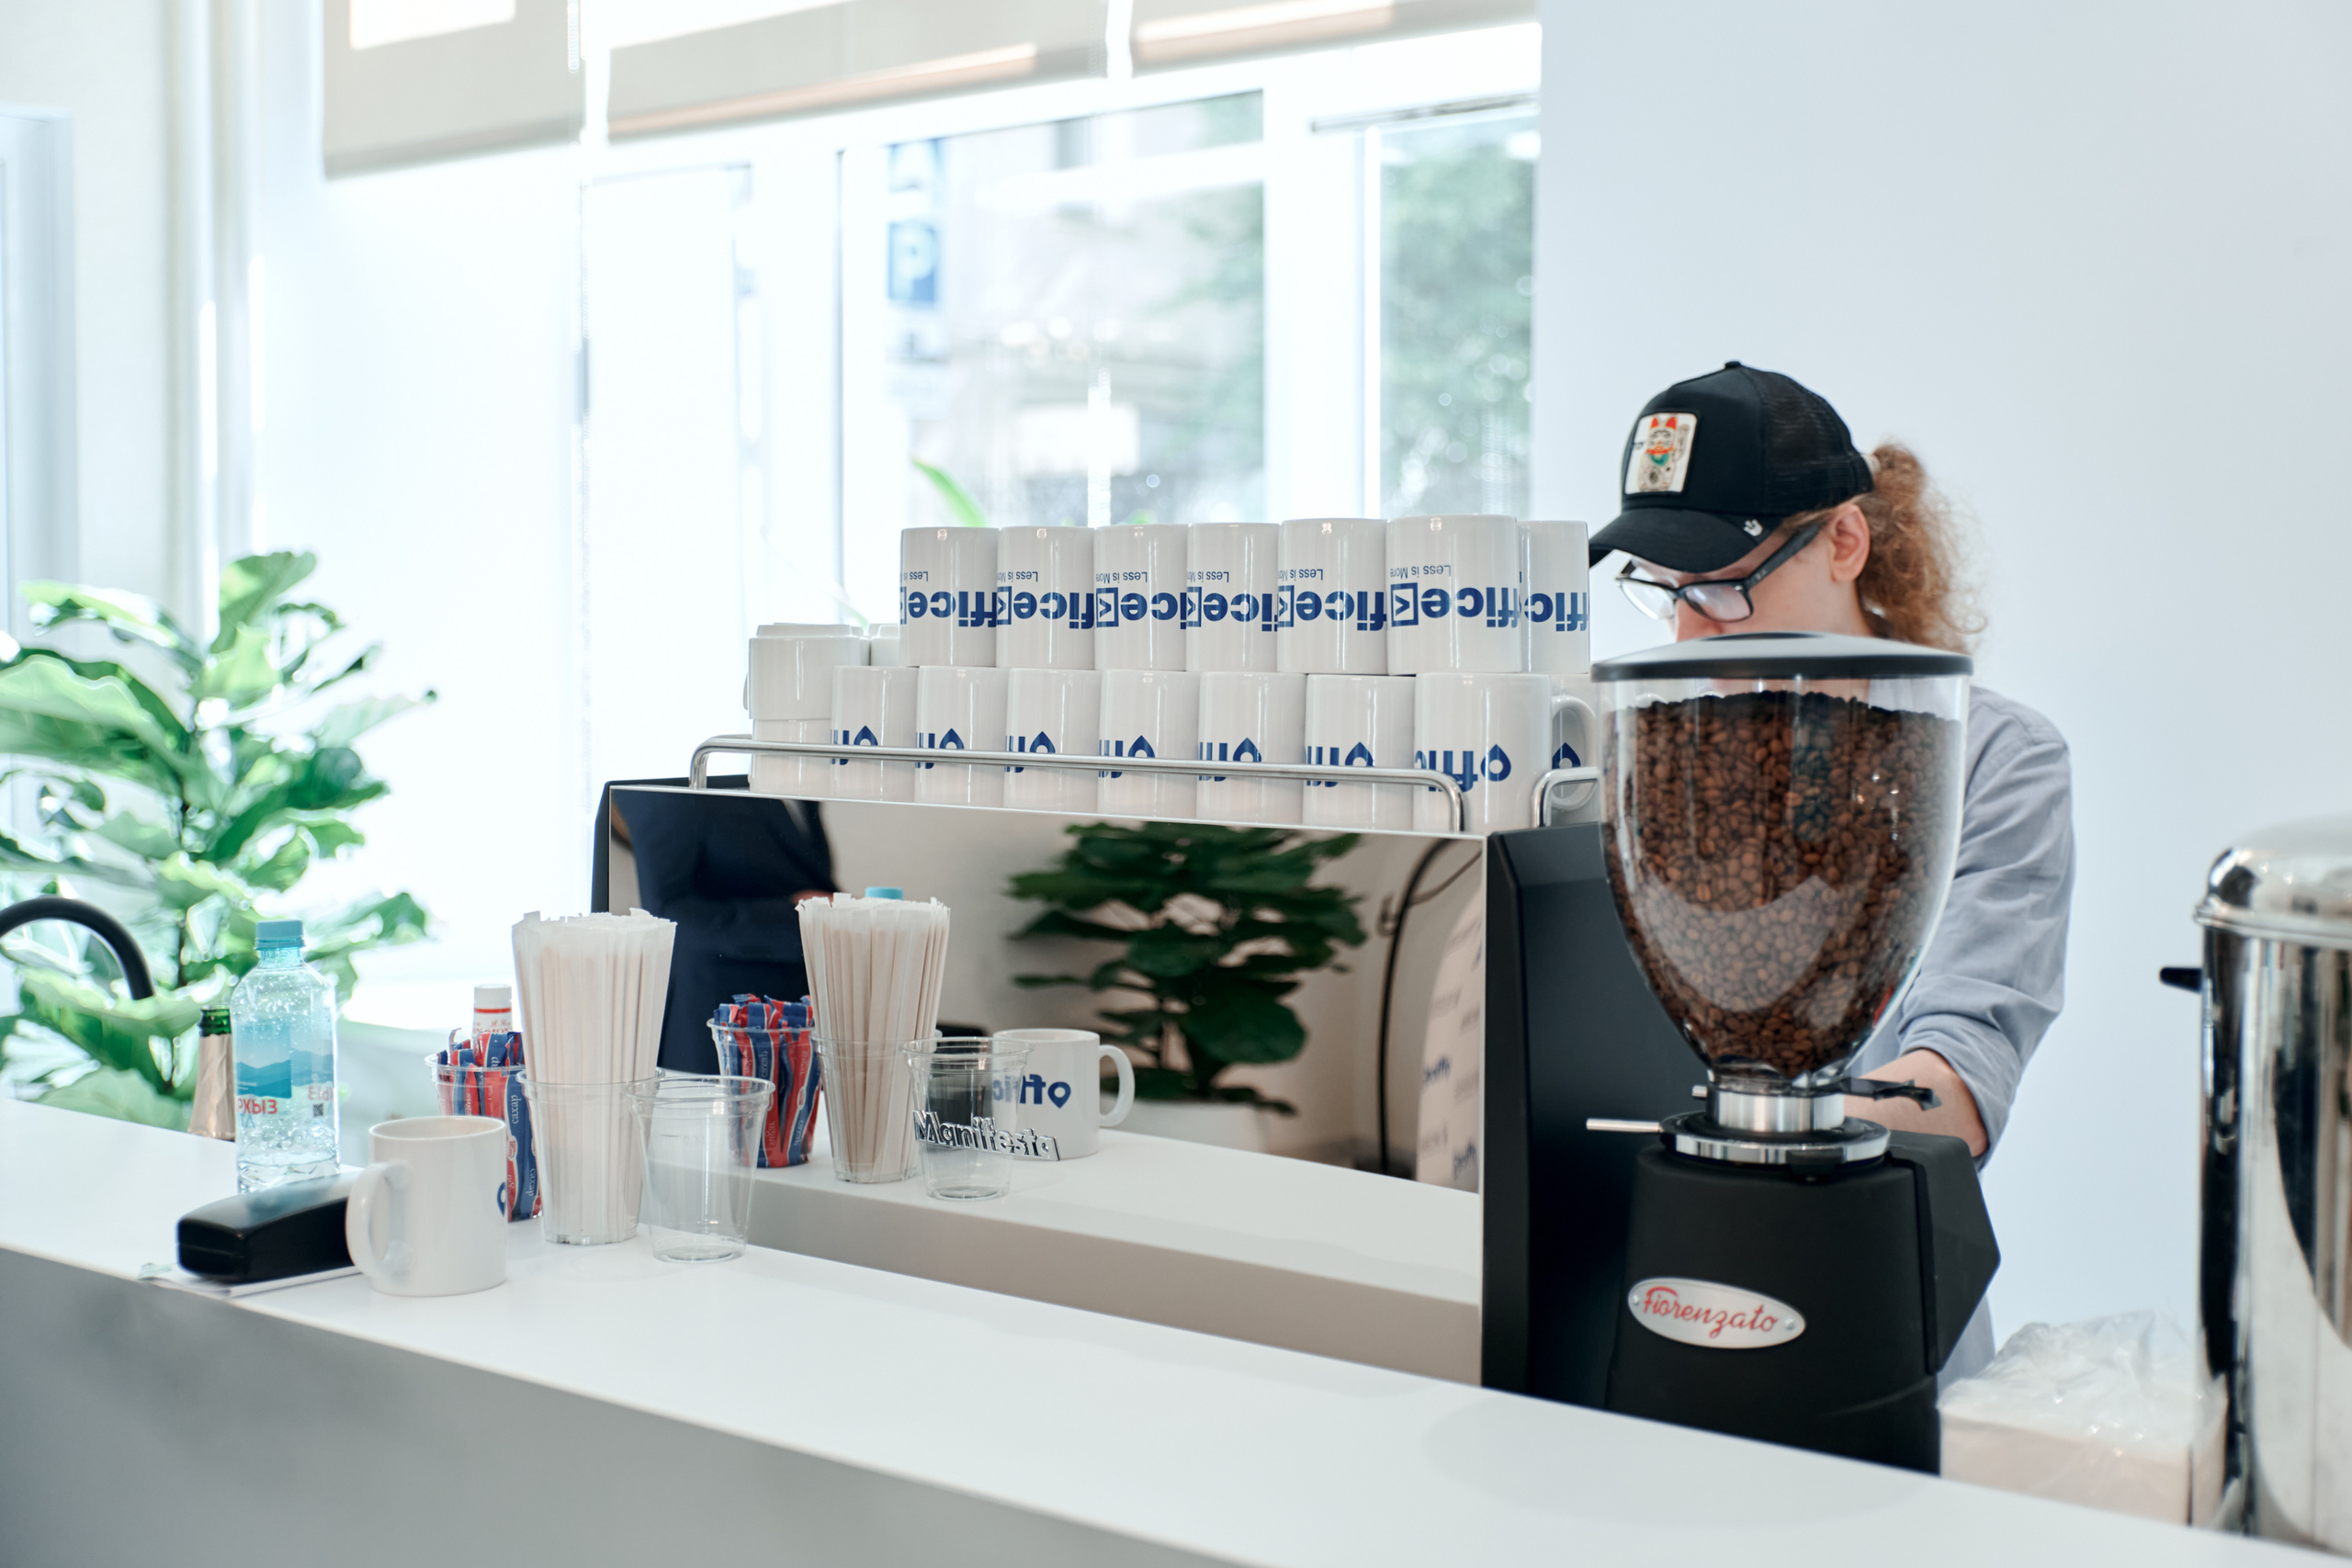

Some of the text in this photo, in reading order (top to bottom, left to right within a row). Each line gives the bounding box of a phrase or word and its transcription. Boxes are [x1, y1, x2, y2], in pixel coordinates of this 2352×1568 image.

[910, 571, 928, 581] Less
[1008, 571, 1013, 582] is
[1016, 571, 1038, 582] Less
[1096, 571, 1148, 583] Less is More
[1197, 571, 1204, 582] is
[1205, 570, 1229, 582] Less
[1290, 570, 1296, 581] is
[1299, 569, 1323, 581] Less
[1390, 565, 1452, 579] Less is More
[511, 1094, 520, 1124] сахар
[1644, 1286, 1778, 1339] Fiorenzato
